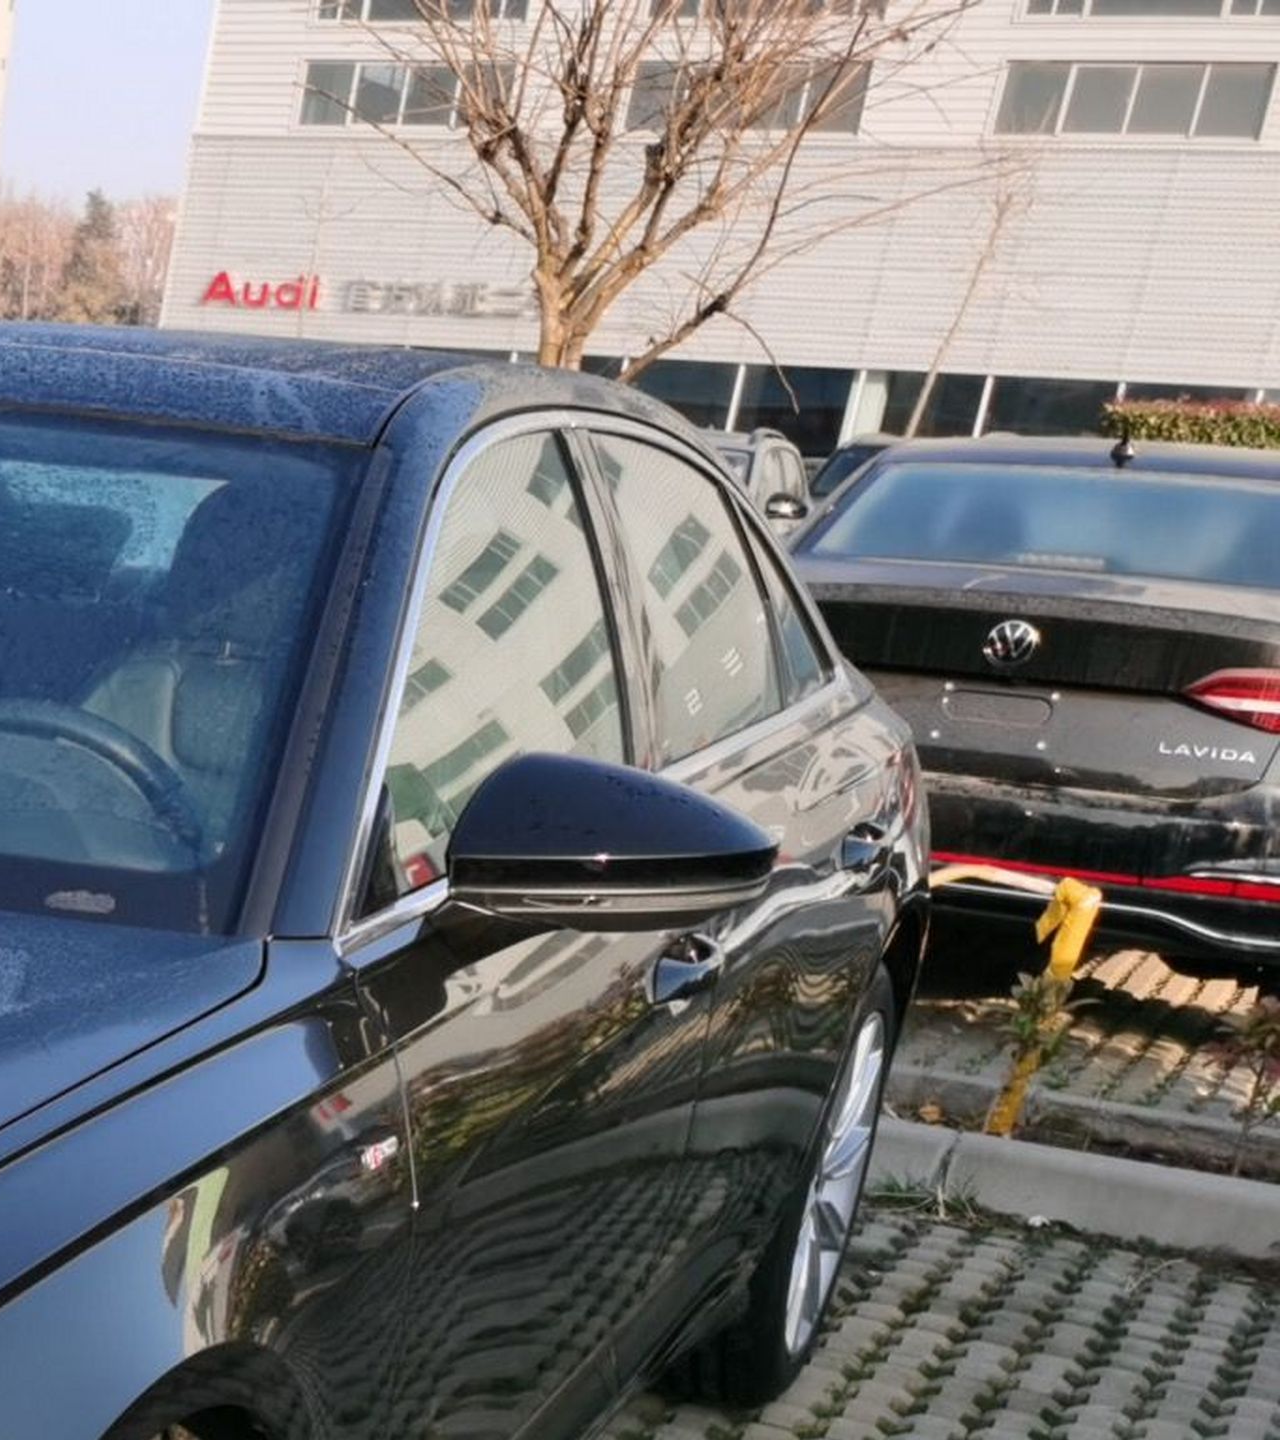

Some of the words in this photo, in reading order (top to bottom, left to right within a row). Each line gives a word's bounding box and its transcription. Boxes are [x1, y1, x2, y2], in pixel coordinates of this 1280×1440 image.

[201, 270, 321, 311] Audi
[343, 278, 538, 319] 官方认证二
[1158, 741, 1257, 763] LAVIDA
